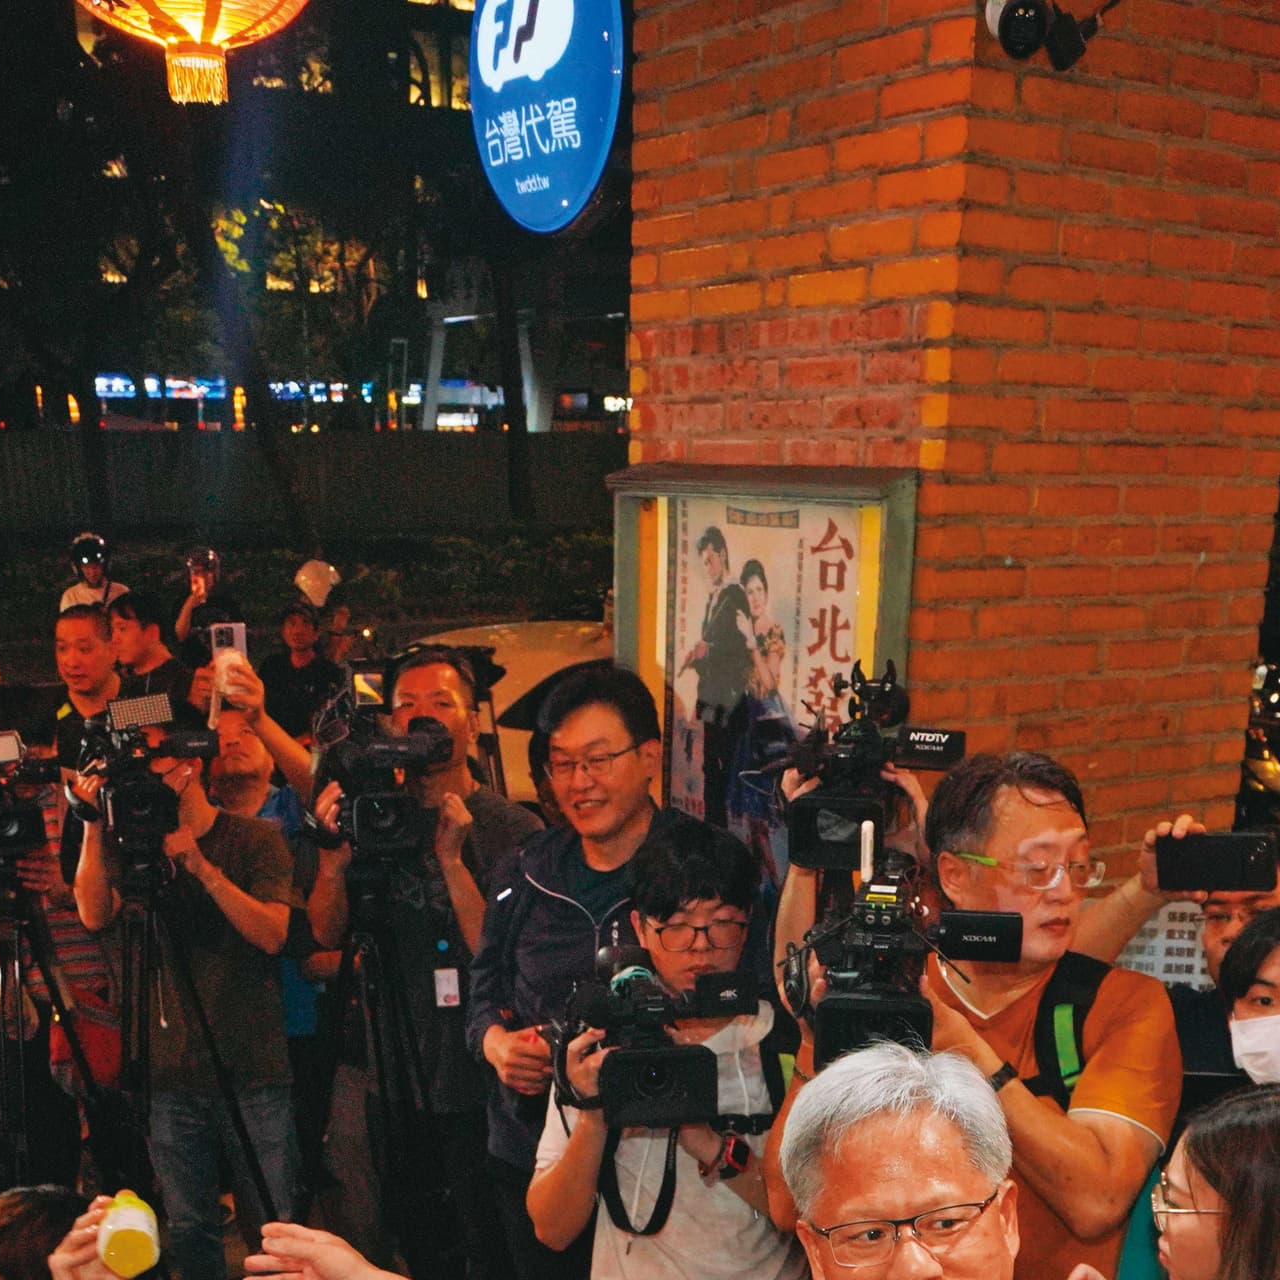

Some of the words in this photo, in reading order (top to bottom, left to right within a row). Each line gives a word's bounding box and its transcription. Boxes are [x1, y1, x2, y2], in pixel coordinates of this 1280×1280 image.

[484, 97, 581, 167] 台灣代駕
[515, 175, 550, 194] twdd.tw
[909, 731, 950, 743] NTDTV
